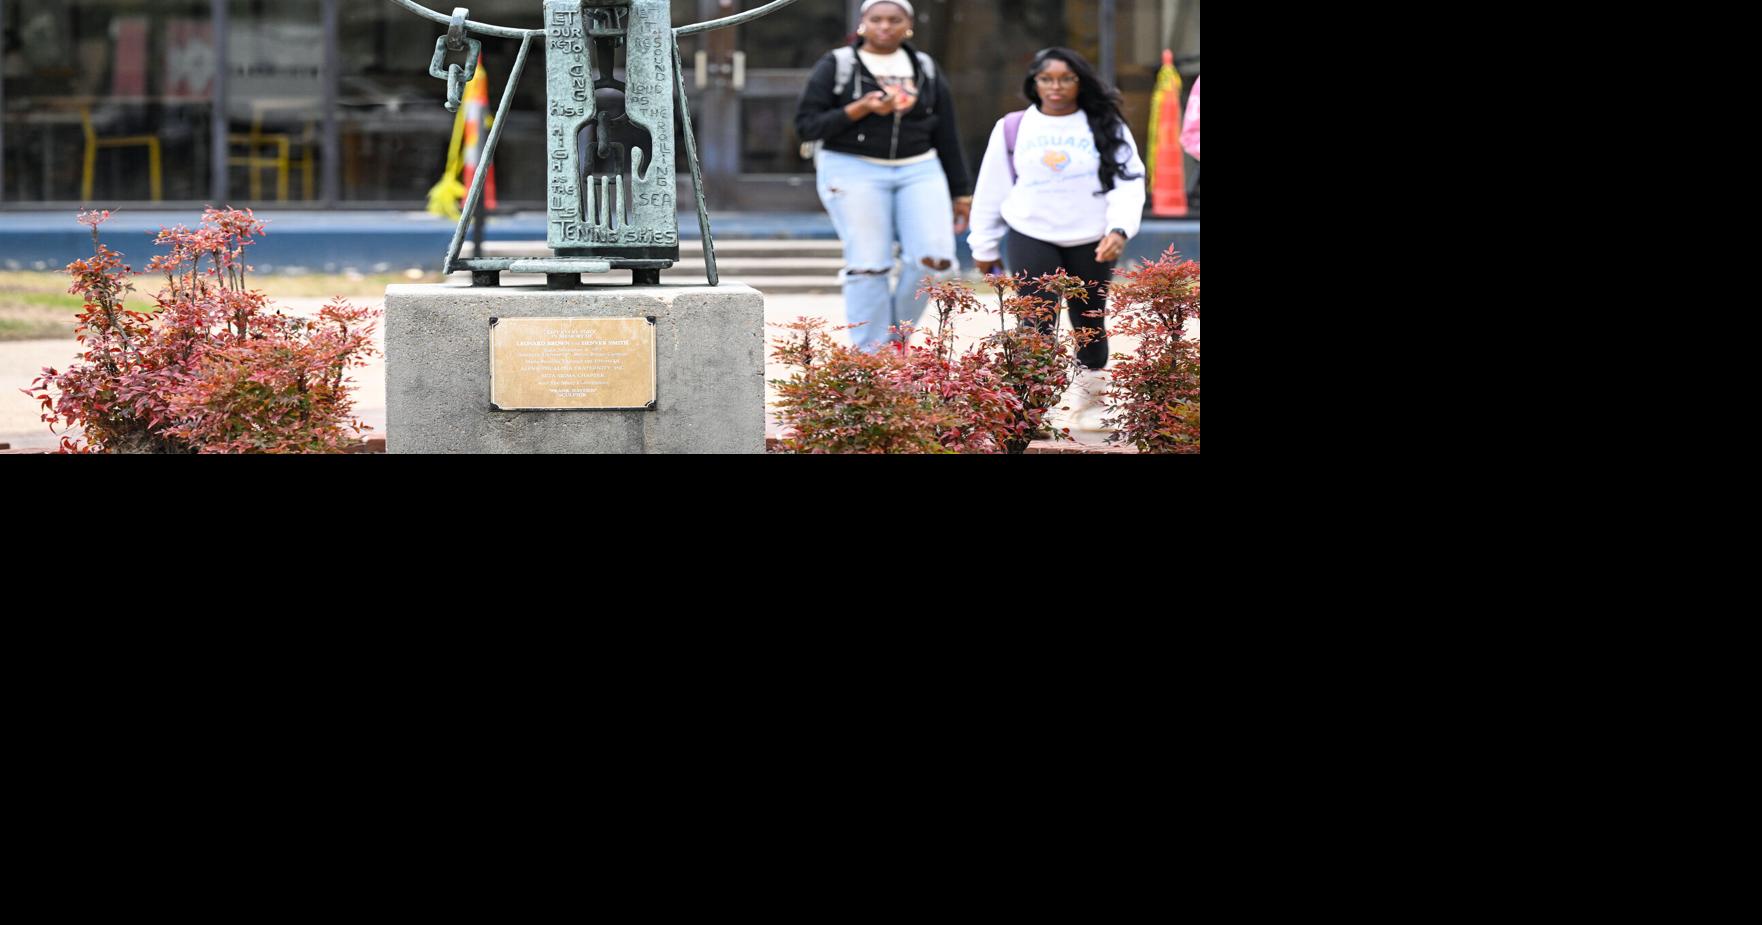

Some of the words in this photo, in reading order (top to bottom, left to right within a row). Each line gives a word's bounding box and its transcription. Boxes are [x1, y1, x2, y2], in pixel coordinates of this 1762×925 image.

[552, 27, 582, 38] OUR
[631, 83, 664, 95] LOUD
[639, 107, 667, 119] THE
[638, 193, 672, 207] SEA
[624, 228, 677, 244] SKIES
